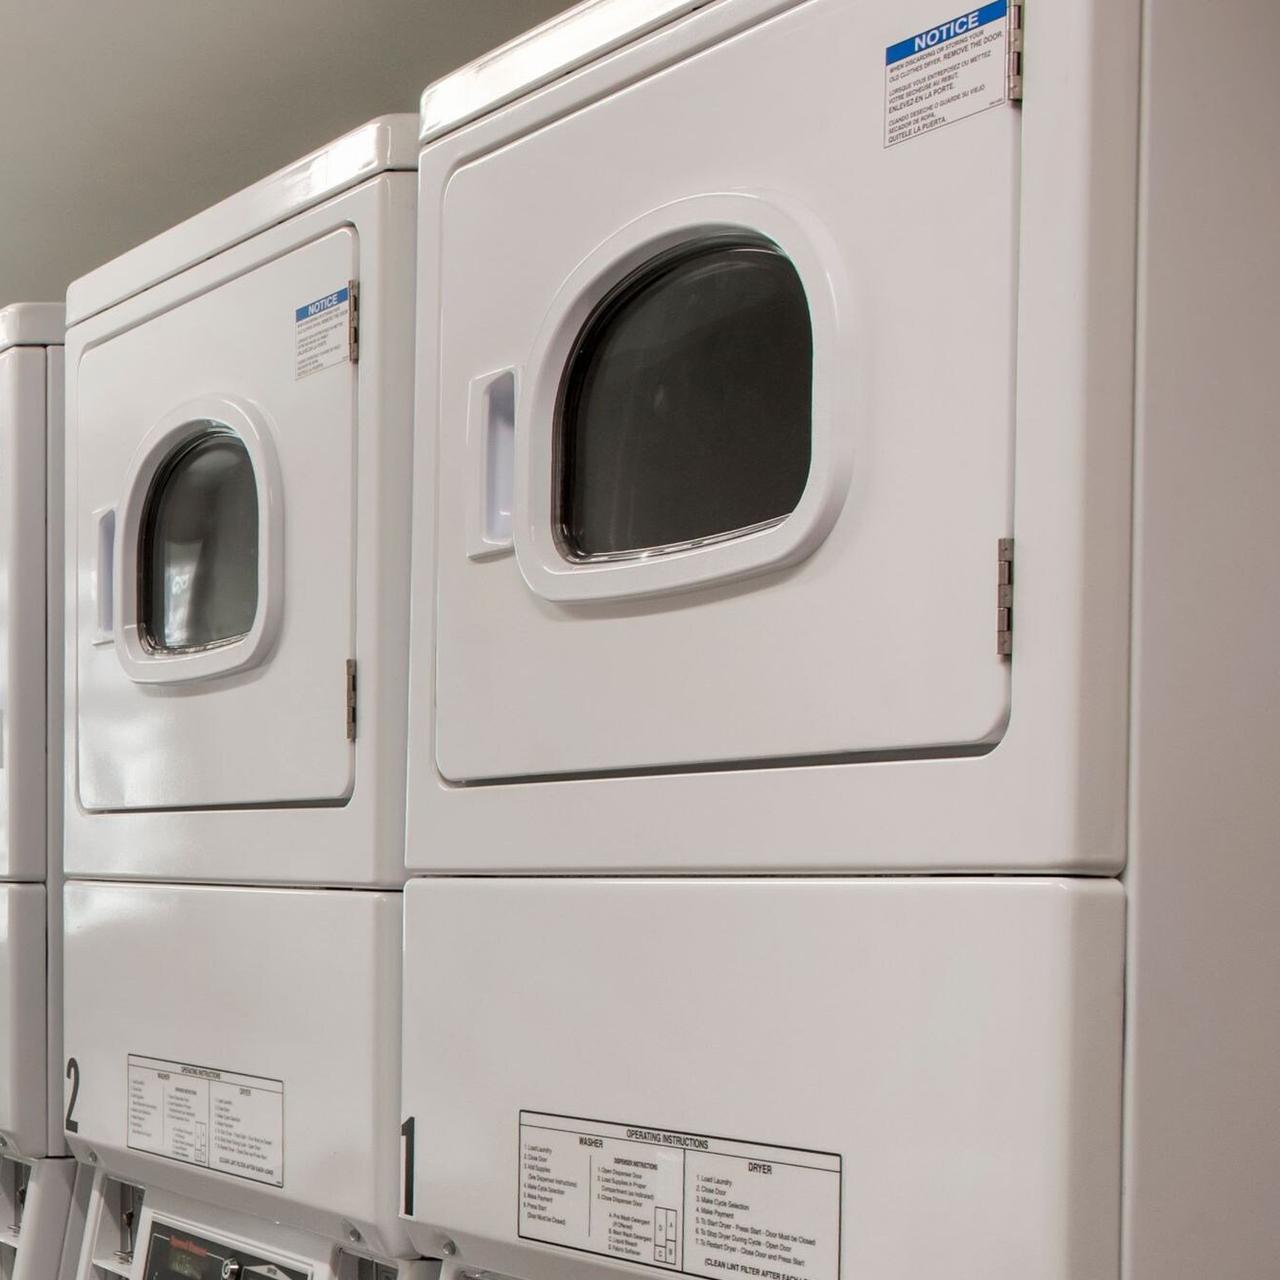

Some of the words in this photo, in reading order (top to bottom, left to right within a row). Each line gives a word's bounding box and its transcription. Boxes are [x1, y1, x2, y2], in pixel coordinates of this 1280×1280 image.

[914, 11, 980, 51] NOTICE
[944, 45, 968, 61] REMOVE
[308, 293, 338, 316] NOTICE
[66, 1057, 80, 1133] 2
[579, 1136, 603, 1148] WASHER
[627, 1129, 660, 1143] OPERATING
[662, 1134, 708, 1150] INSTRUCTIONS
[401, 1116, 415, 1216] 1
[748, 1162, 772, 1175] DRYER
[705, 1257, 726, 1270] (CLEAN
[727, 1262, 739, 1273] LINT
[741, 1265, 760, 1278] FILTER
